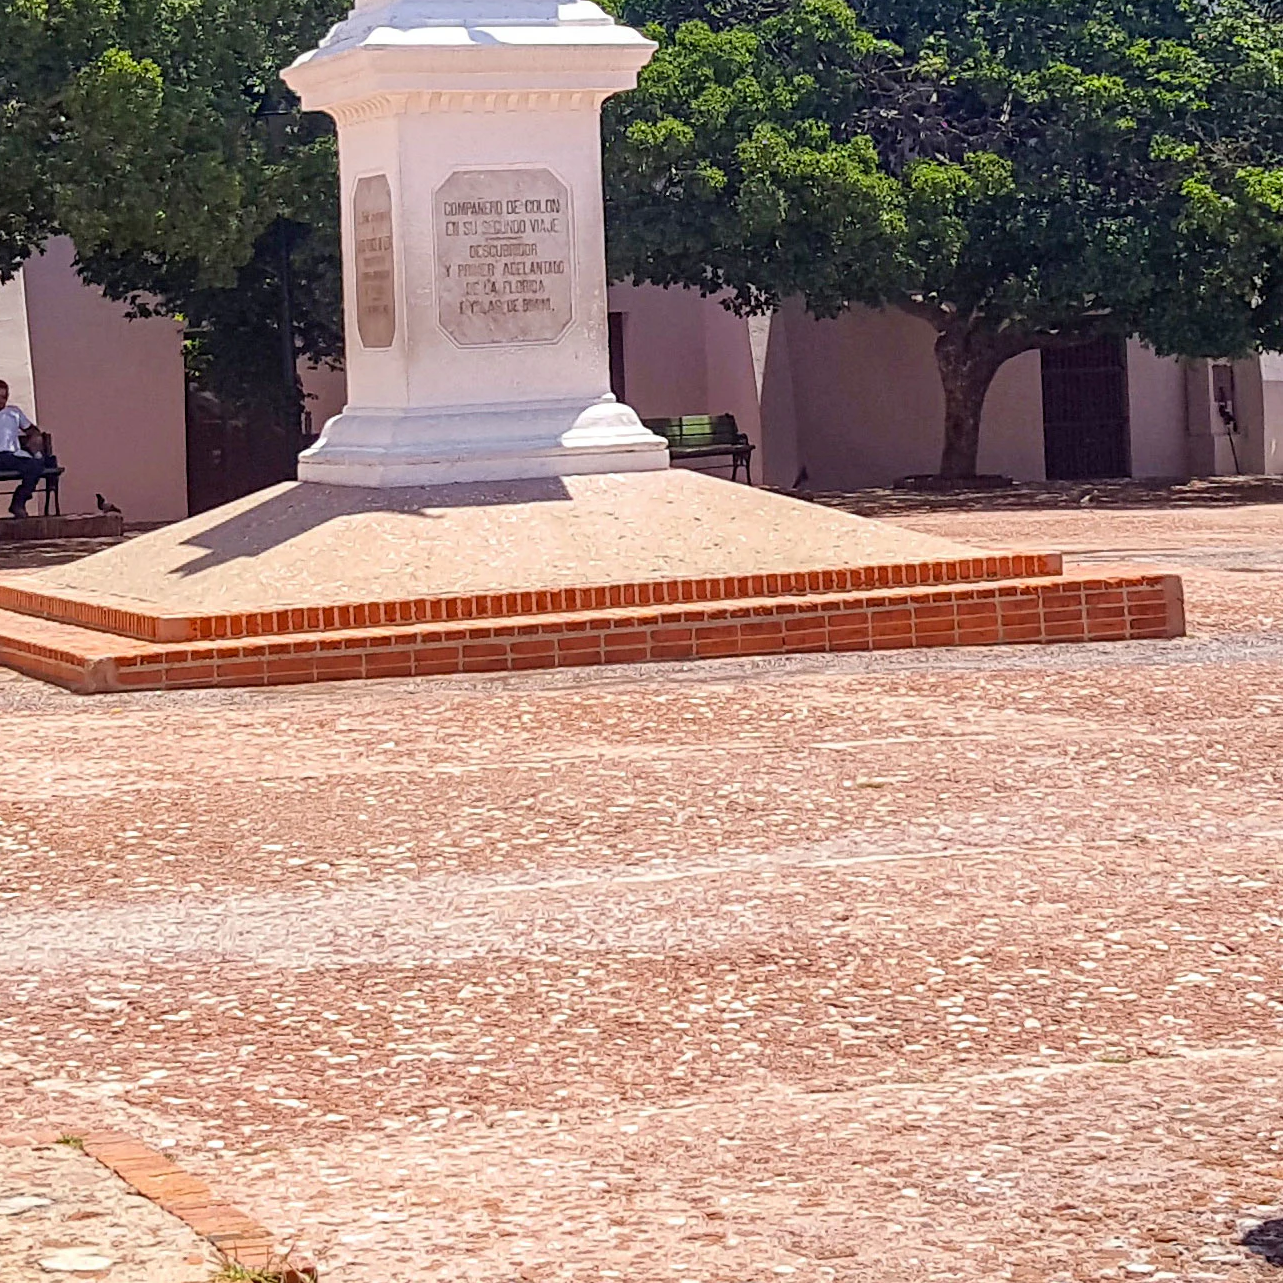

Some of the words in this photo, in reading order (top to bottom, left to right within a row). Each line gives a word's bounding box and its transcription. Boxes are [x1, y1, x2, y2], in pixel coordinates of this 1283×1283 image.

[507, 199, 522, 215] DE
[525, 198, 561, 214] COLON
[463, 220, 478, 235] SU
[529, 218, 561, 233] VIAJE
[445, 264, 452, 277] Y
